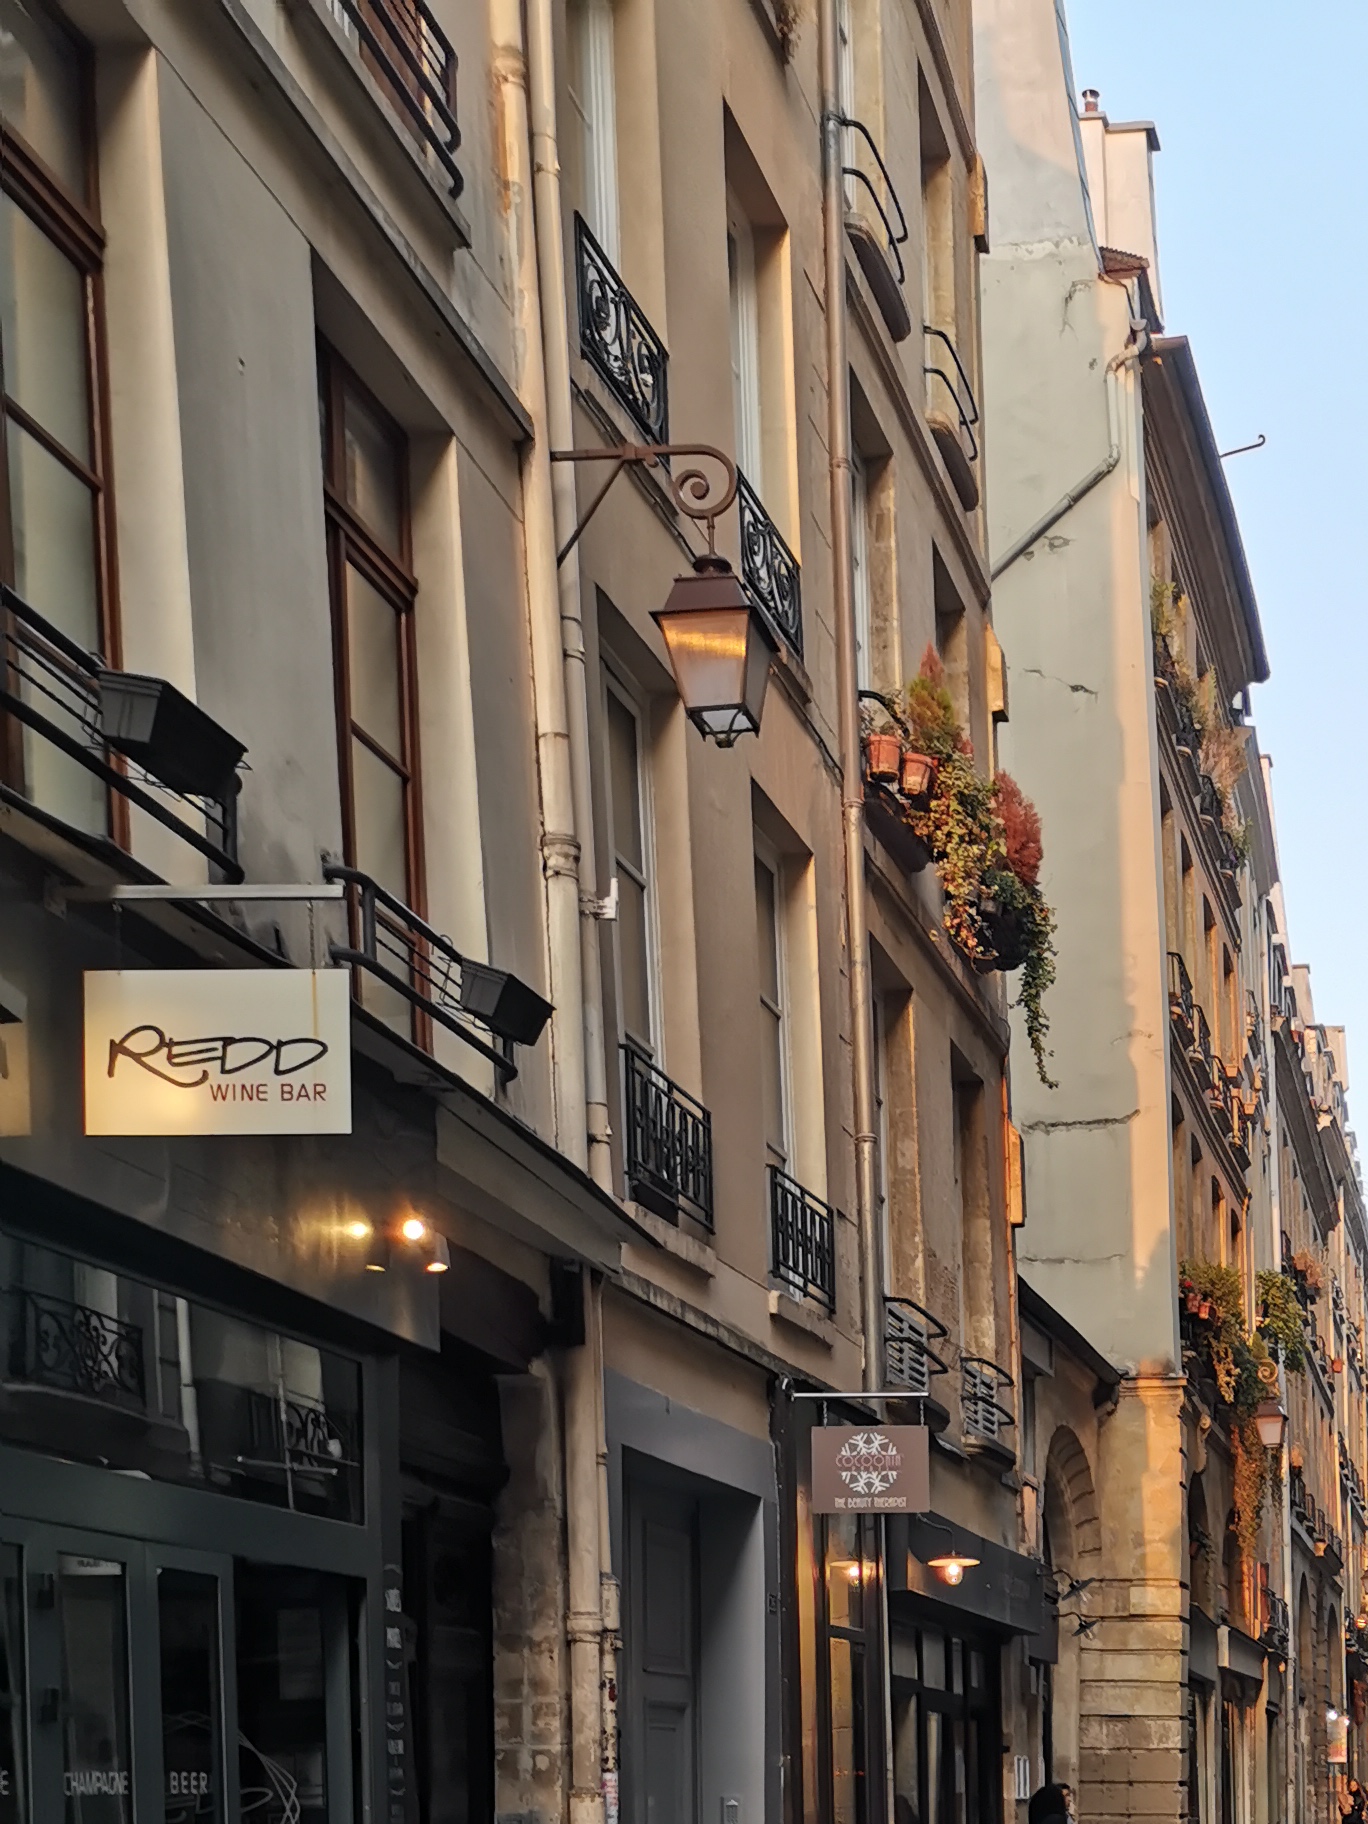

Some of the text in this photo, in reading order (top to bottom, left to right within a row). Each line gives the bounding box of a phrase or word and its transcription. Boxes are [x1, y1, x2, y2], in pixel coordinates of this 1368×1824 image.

[107, 1025, 328, 1088] REDD
[210, 1083, 327, 1101] WINE BAR
[64, 1770, 129, 1796] CHAMPAGNE
[169, 1771, 208, 1795] BEER
